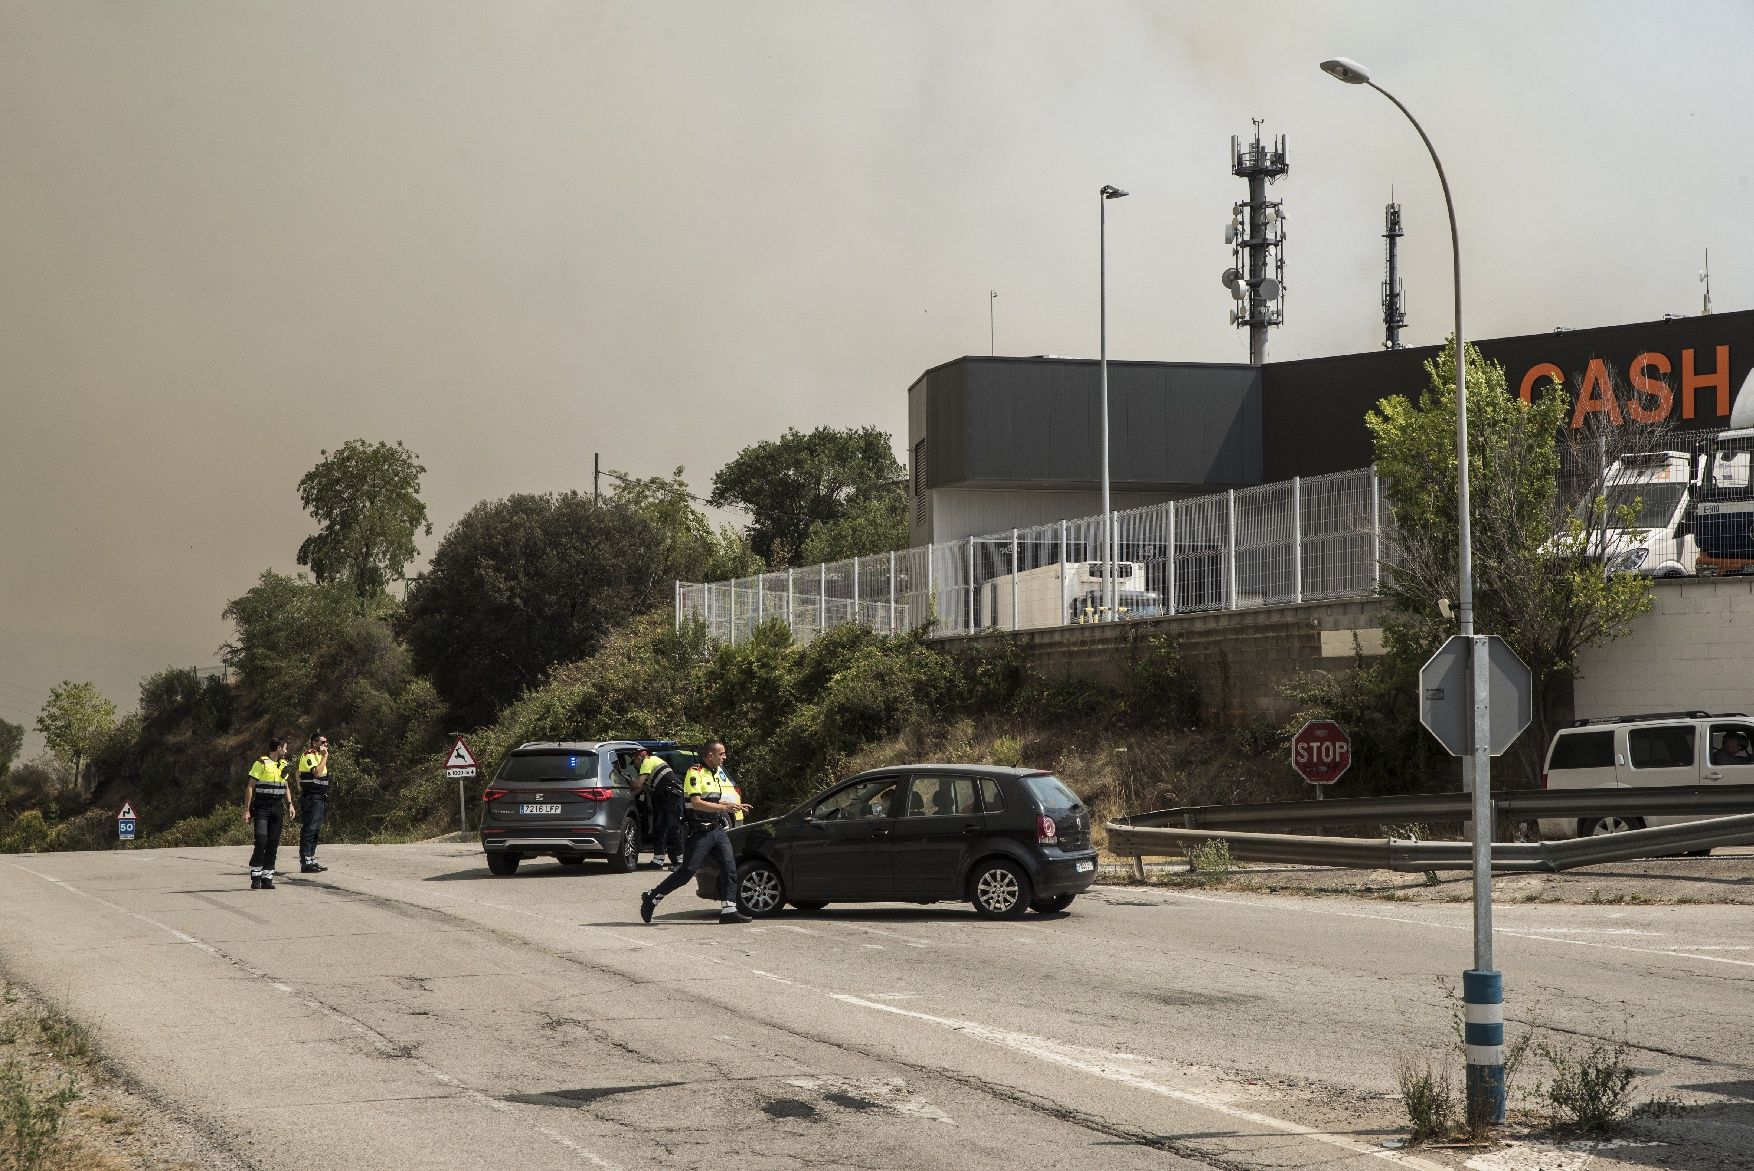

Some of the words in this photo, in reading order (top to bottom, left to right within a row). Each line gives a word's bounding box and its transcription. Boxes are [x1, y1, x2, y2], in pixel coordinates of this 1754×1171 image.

[1520, 345, 1730, 429] CASH
[1297, 741, 1348, 762] STOP
[524, 804, 543, 813] 7216
[545, 804, 560, 813] LFP
[120, 823, 134, 832] 50
